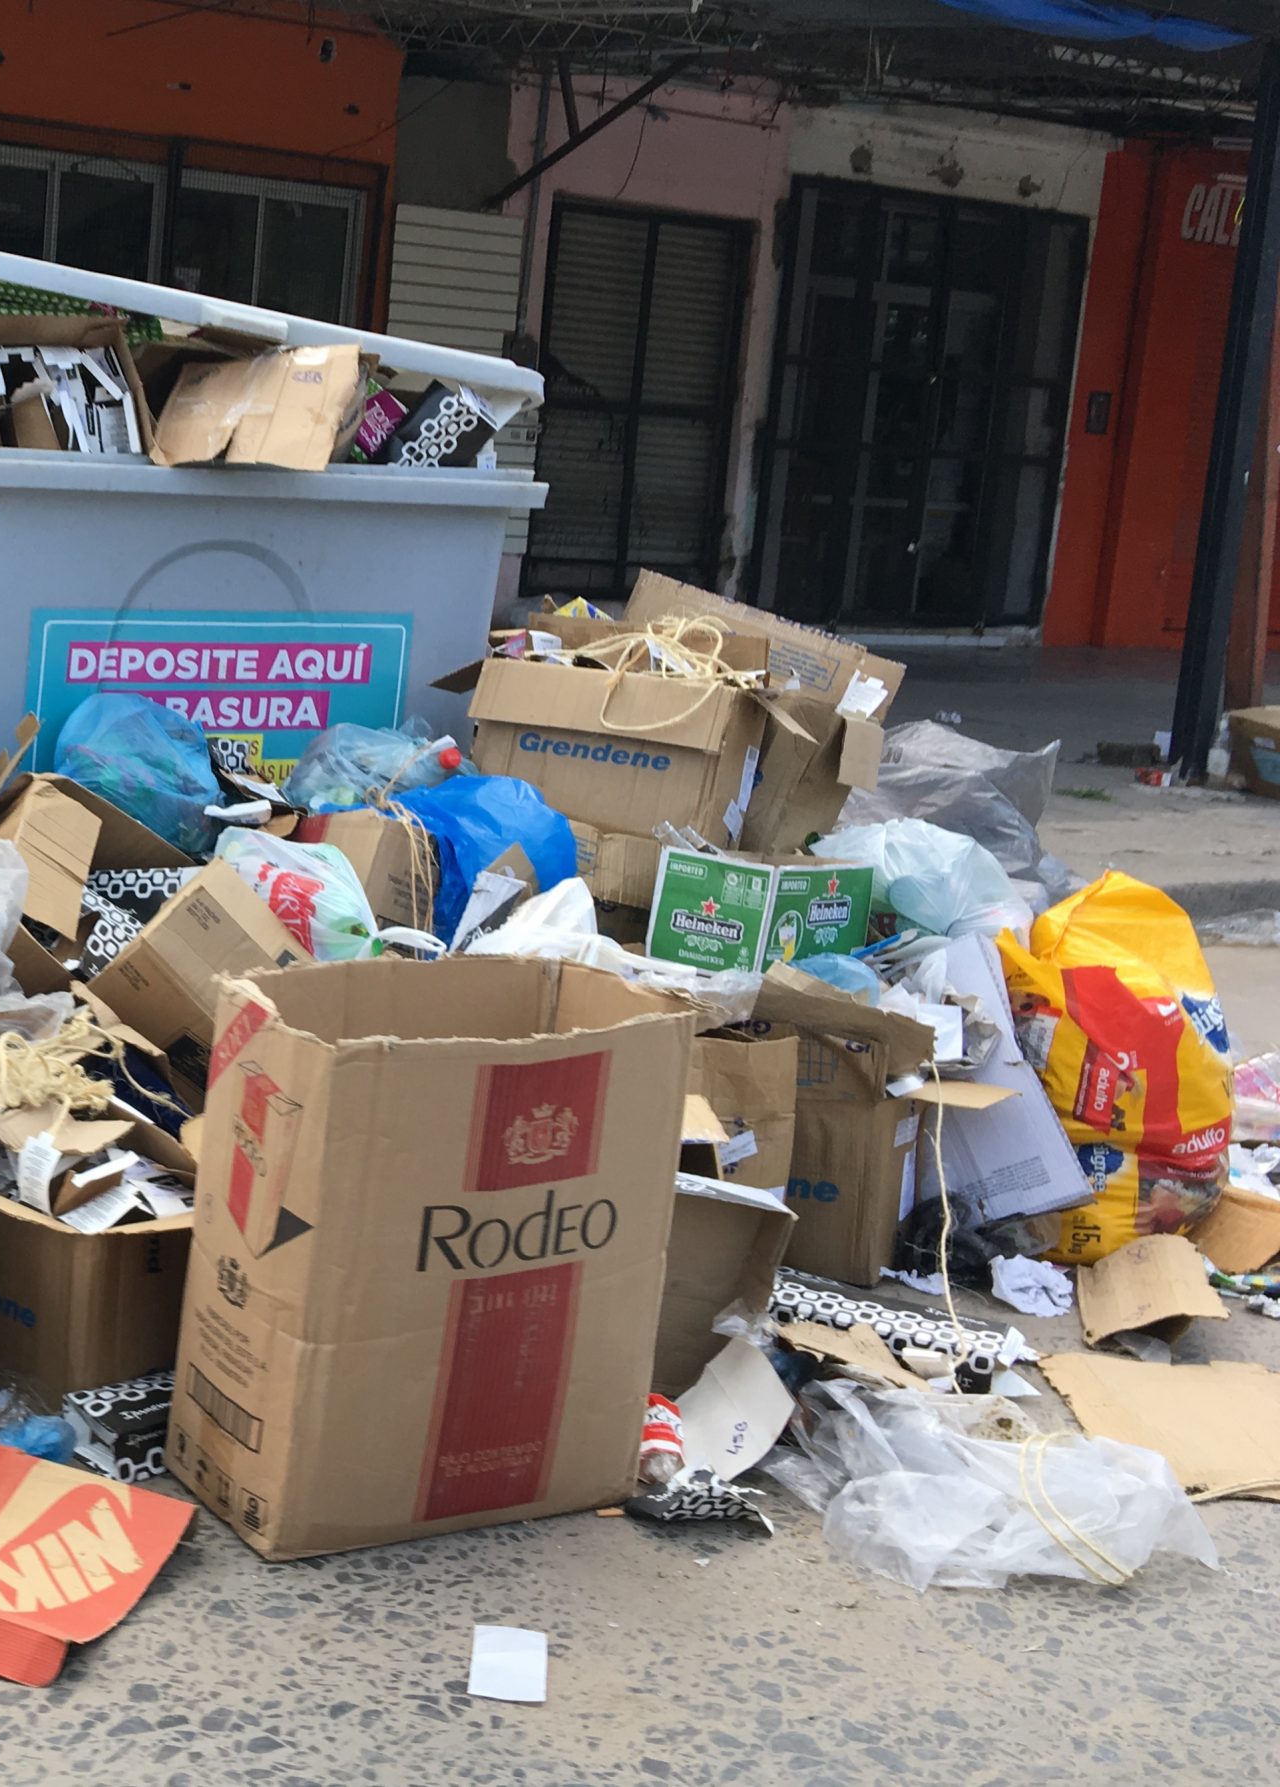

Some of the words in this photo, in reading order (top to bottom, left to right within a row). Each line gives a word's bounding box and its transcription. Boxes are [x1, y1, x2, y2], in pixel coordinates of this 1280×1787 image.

[1181, 183, 1246, 248] CAL
[69, 647, 260, 680] DEPOSITE
[267, 642, 367, 680] AQUÍ
[165, 696, 322, 728] BASURA
[519, 731, 671, 772] Grendene
[670, 862, 705, 877] IMPORTED
[780, 879, 809, 891] IMPORTED
[809, 900, 849, 922] Heineken
[674, 913, 739, 940] Heineken
[1094, 1067, 1111, 1112] adulto
[1172, 1126, 1226, 1155] adulto
